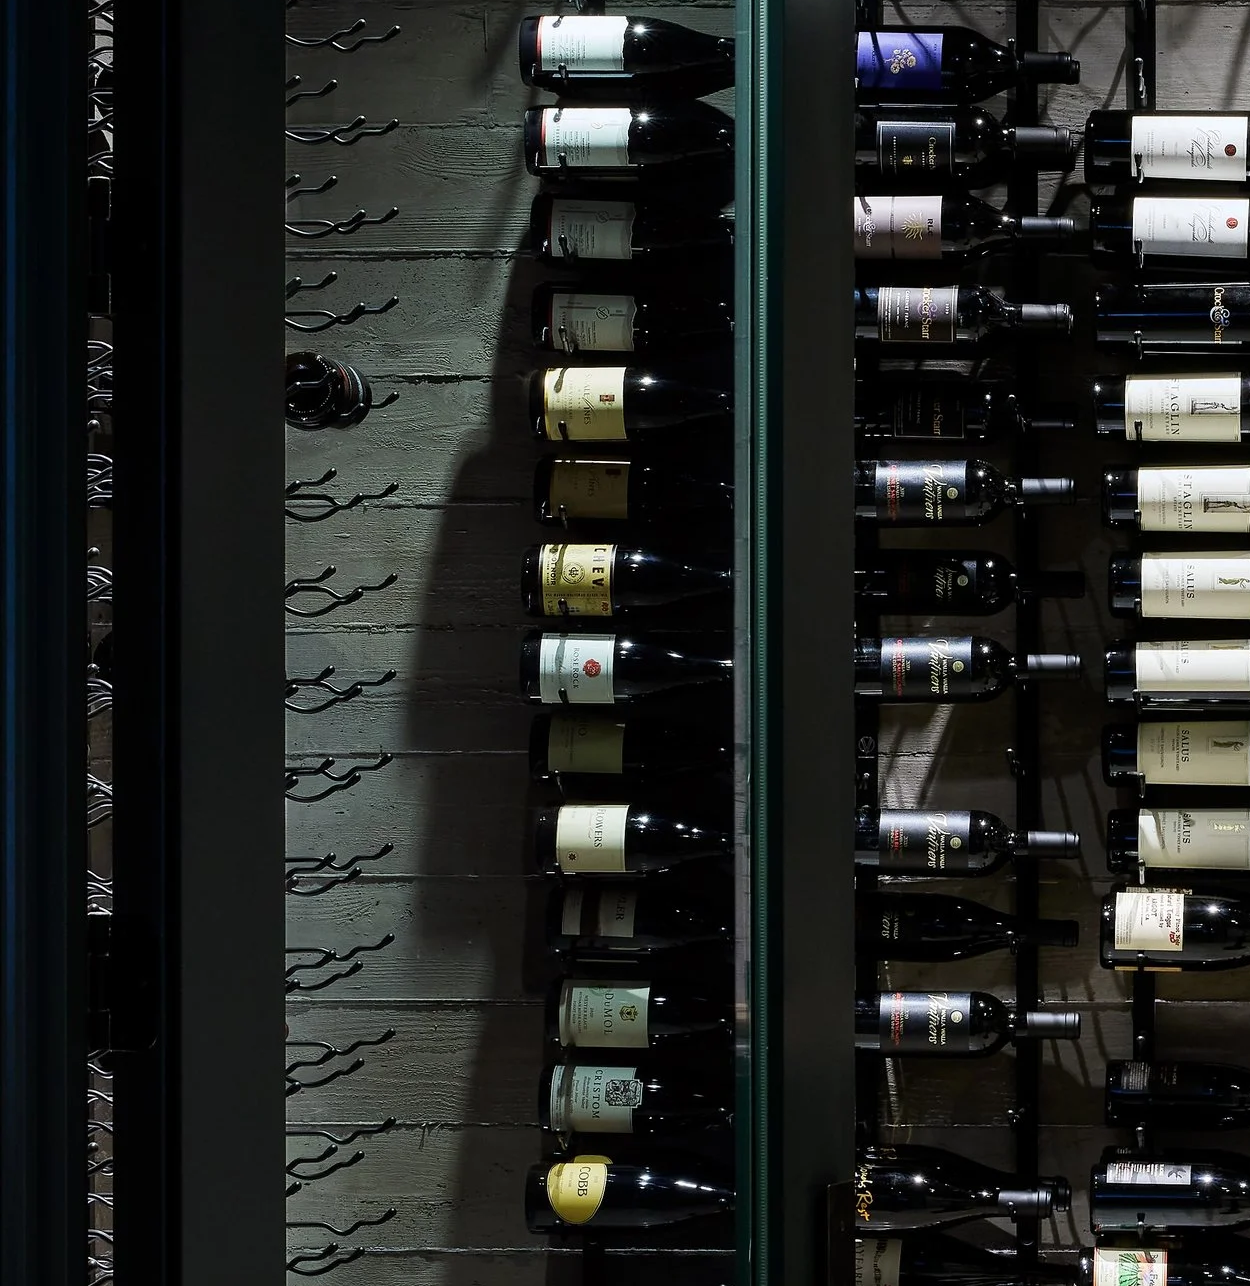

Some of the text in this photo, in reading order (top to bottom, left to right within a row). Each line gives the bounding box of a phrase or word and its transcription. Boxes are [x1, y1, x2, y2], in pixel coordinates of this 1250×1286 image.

[928, 136, 937, 166] Crocker
[921, 316, 933, 340] Starr
[1213, 323, 1225, 345] Starr
[932, 413, 944, 436] Starr
[1170, 378, 1180, 436] STAGLIN
[922, 464, 948, 519] Vintners
[1182, 474, 1193, 530] STAGLIN
[549, 567, 557, 586] NOIR
[1186, 564, 1195, 599] SALUS
[928, 639, 954, 694] Vintners
[1180, 729, 1190, 763] SALUS
[593, 808, 607, 848] FLOWERS
[925, 813, 951, 869] Vintners
[1181, 813, 1192, 845] SALUS
[603, 992, 615, 1036] DuMOL
[927, 992, 952, 1045] Vintners
[591, 1069, 604, 1120] CRISTOM
[577, 1166, 592, 1197] COBB
[855, 1190, 874, 1222] Rest
